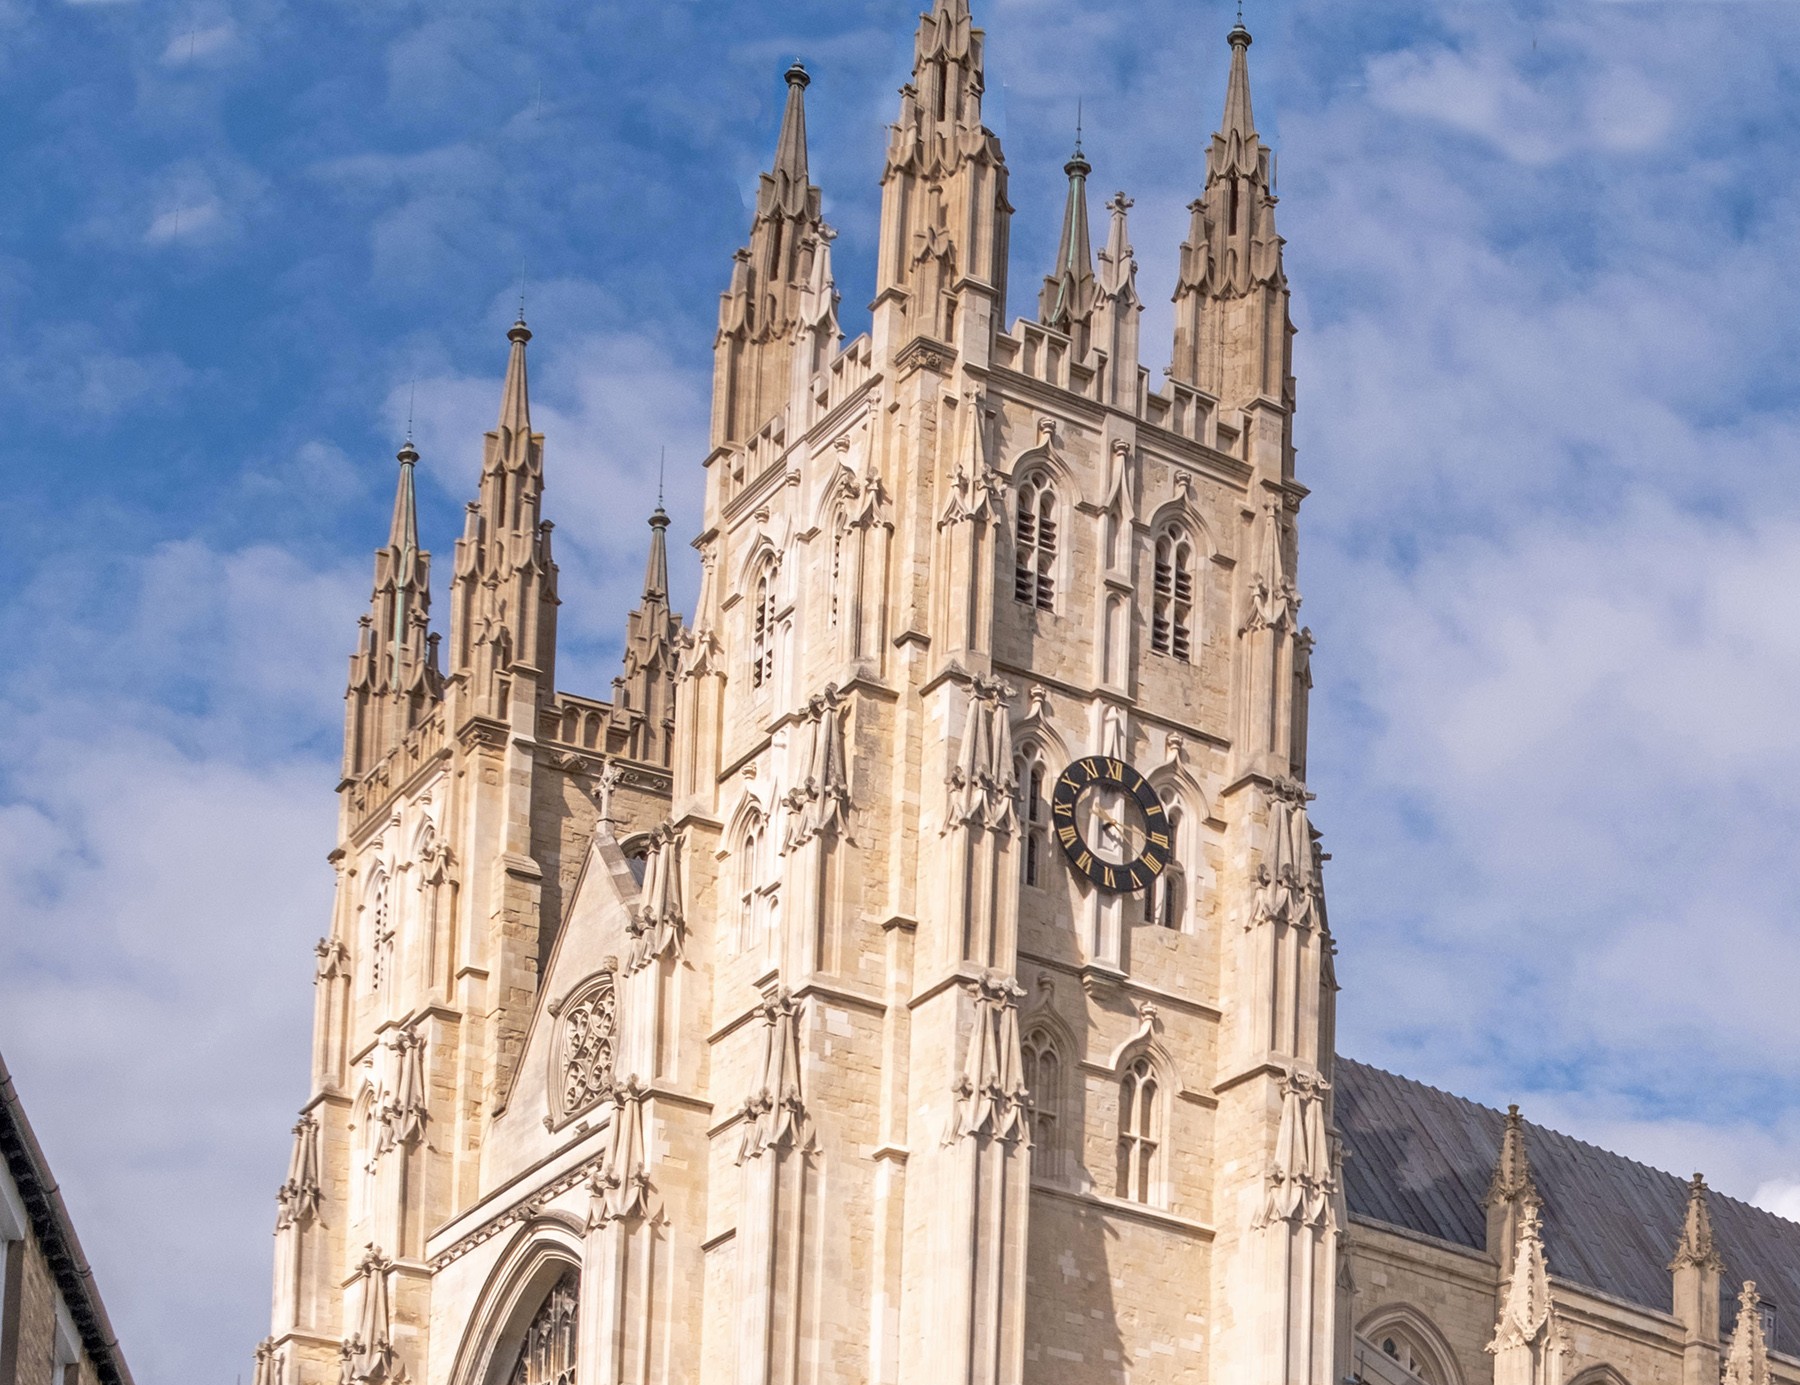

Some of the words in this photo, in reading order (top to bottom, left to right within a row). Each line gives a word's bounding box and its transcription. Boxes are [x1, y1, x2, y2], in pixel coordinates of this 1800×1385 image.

[1080, 759, 1099, 781] XI
[1105, 759, 1123, 782] XII
[1061, 772, 1081, 794] X
[1132, 777, 1144, 793] I
[1054, 798, 1073, 817] IX
[1146, 805, 1162, 816] II
[1058, 825, 1077, 848] VIII
[1151, 831, 1169, 848] III
[1076, 850, 1092, 875] VII
[1144, 852, 1162, 875] IIII
[1103, 866, 1116, 888] VI
[1130, 868, 1143, 888] V
